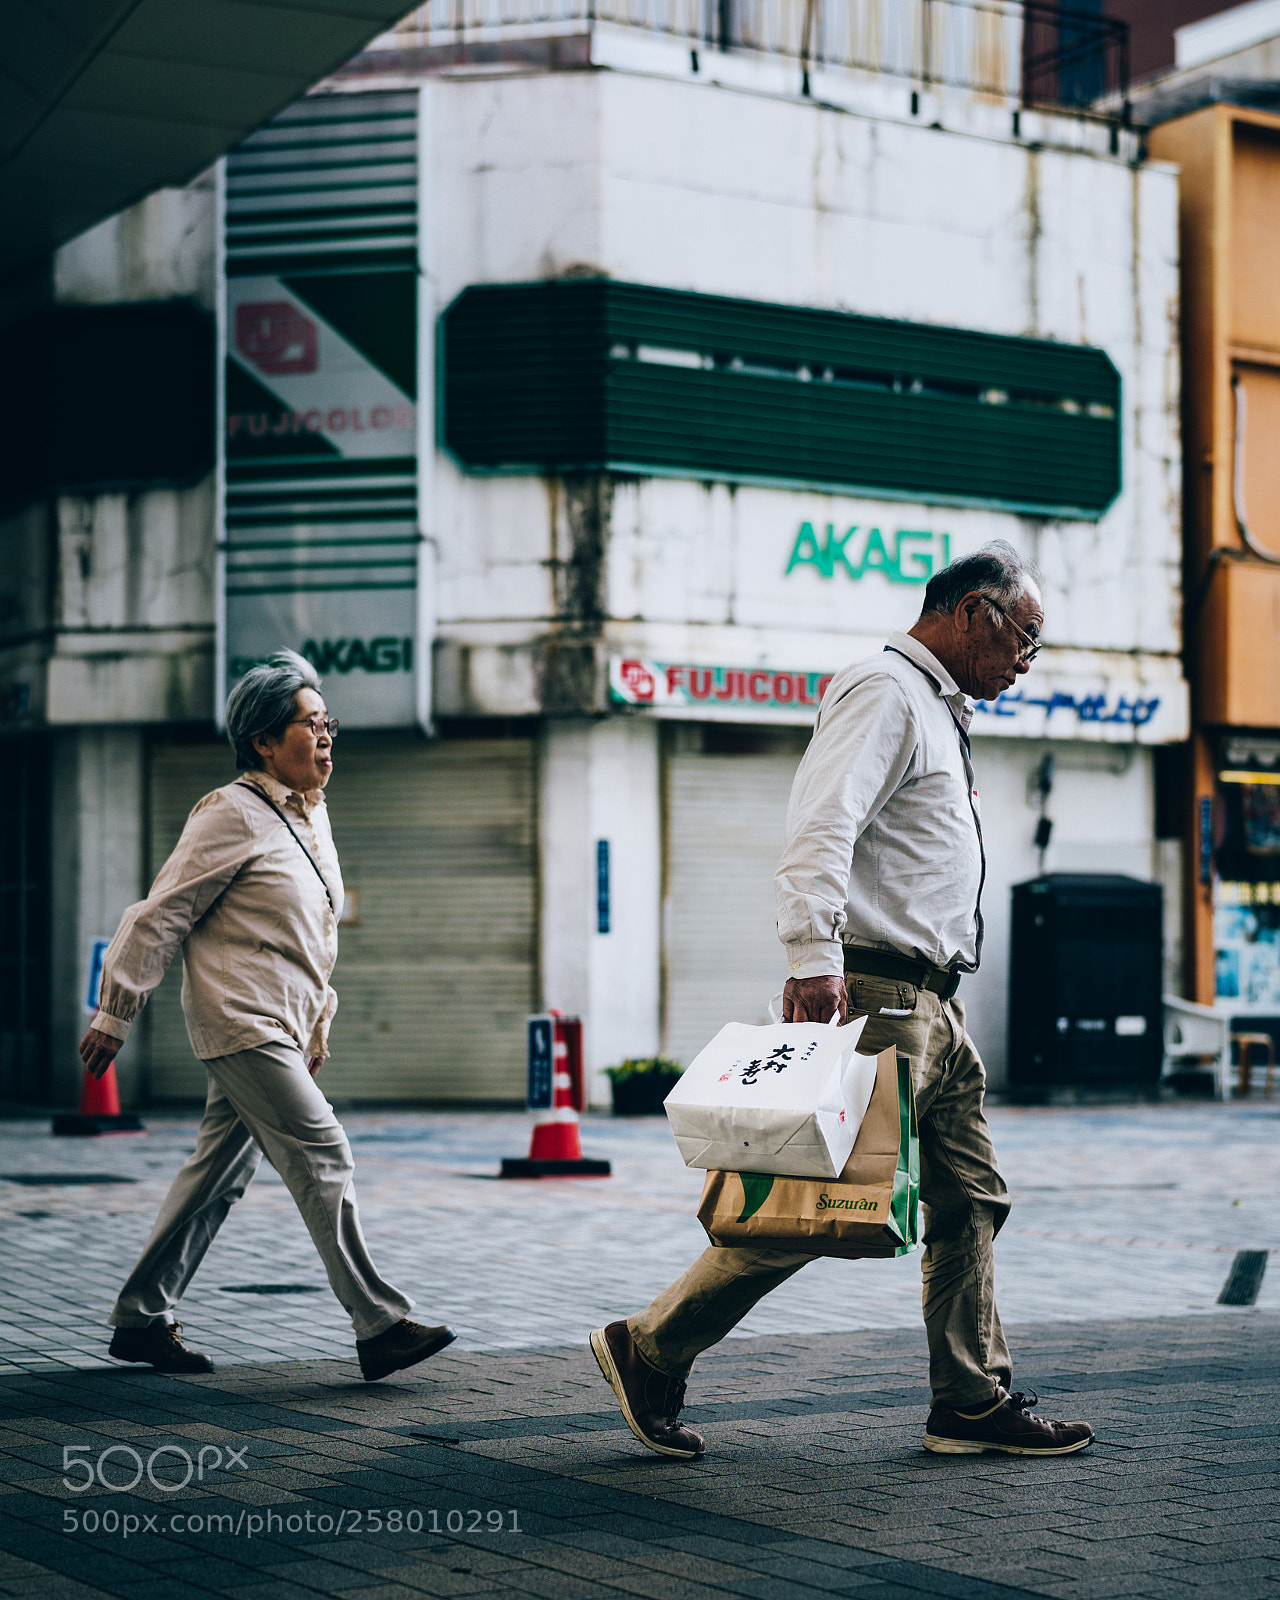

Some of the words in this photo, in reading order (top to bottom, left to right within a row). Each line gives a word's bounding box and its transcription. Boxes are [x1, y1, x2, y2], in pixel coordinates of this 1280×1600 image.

[228, 405, 414, 438] FUJICOLOR
[784, 521, 951, 584] AKAGI
[301, 637, 413, 674] AKAGI
